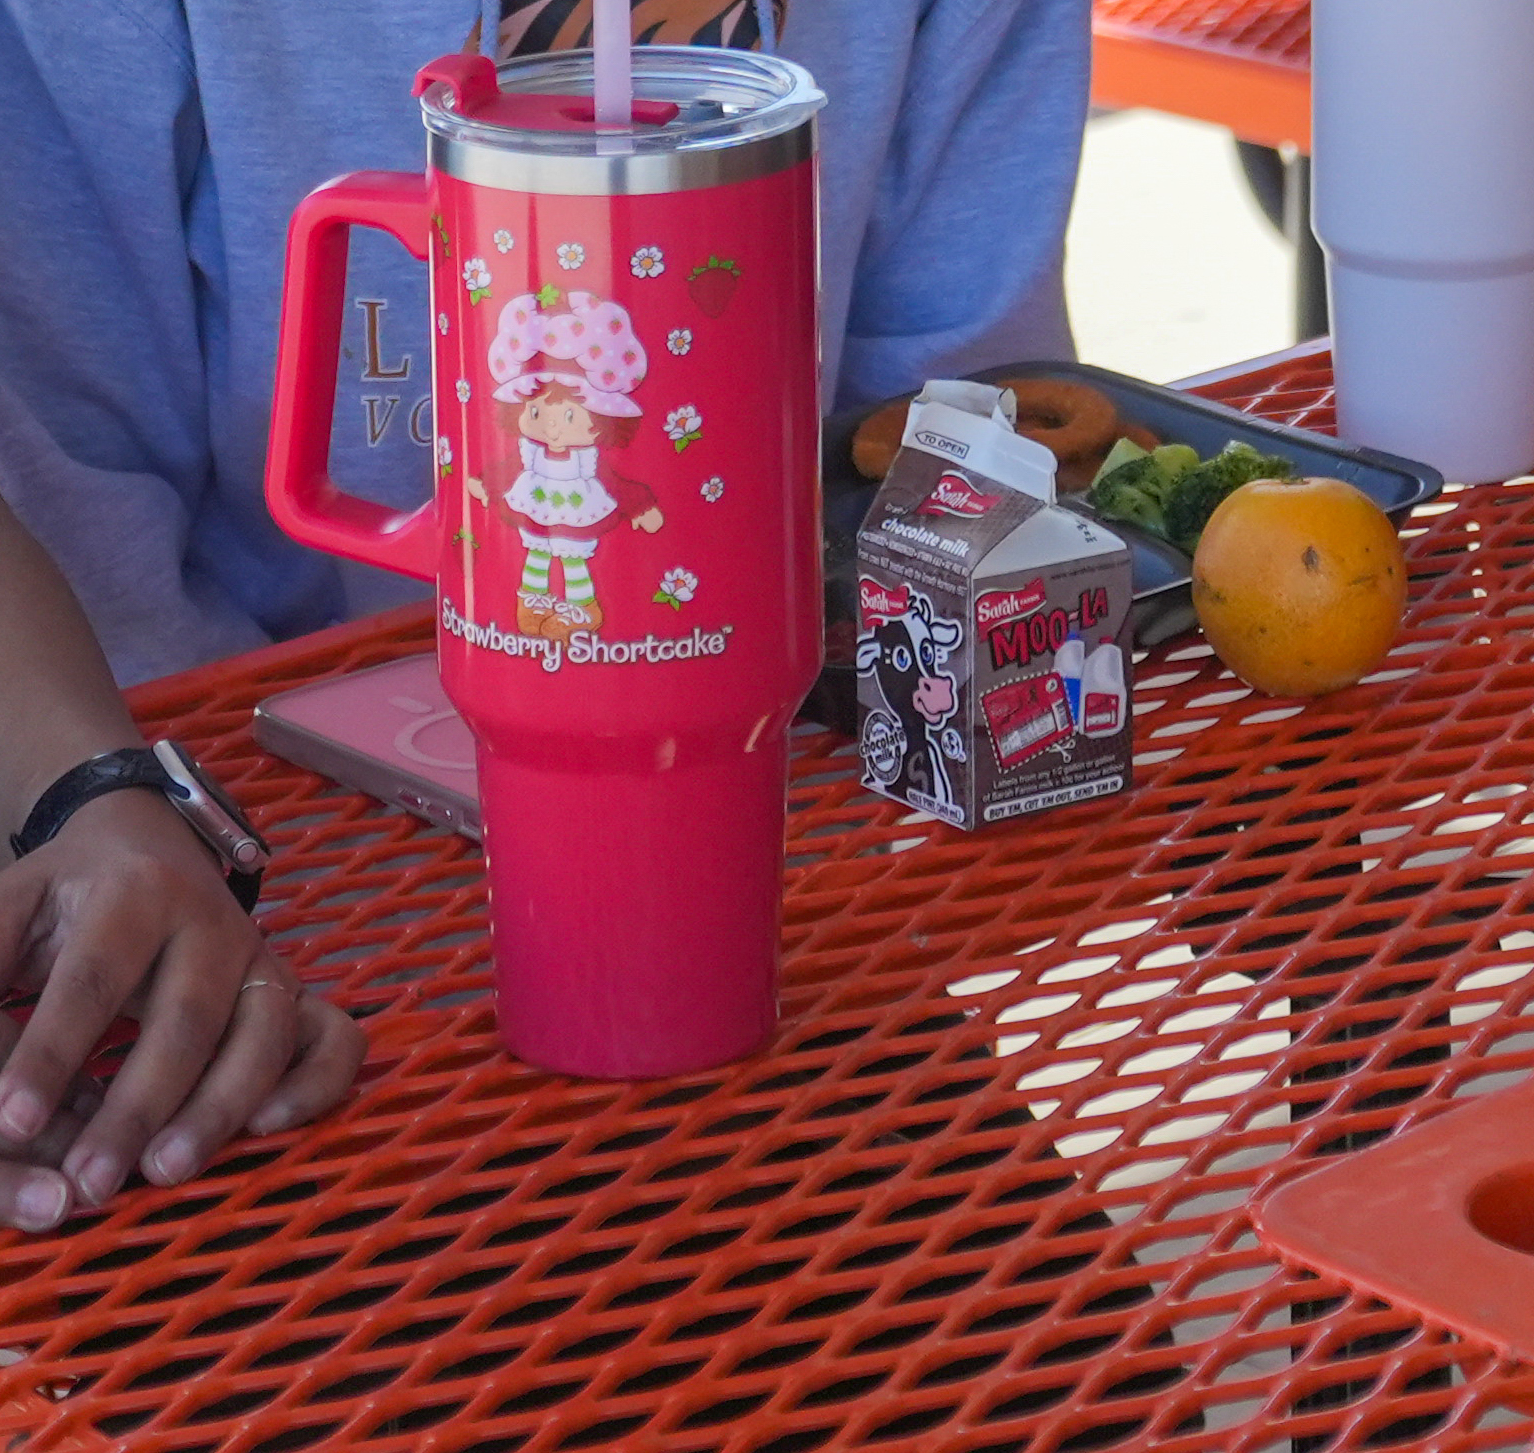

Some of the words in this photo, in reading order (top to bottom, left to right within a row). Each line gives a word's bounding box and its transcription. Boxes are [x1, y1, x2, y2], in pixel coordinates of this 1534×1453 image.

[923, 434, 937, 445] TO
[937, 437, 966, 455] OPEN
[881, 518, 940, 548] chocolate
[938, 537, 970, 558] milk
[860, 587, 890, 612] Sarah
[977, 595, 1020, 623] Sarah
[441, 597, 561, 672] Strawberry
[988, 587, 1109, 671] MOO-LA
[989, 805, 1006, 820] BUY
[1023, 798, 1041, 811] CUT
[1073, 786, 1095, 799] SEND
[1109, 780, 1119, 791] IN
